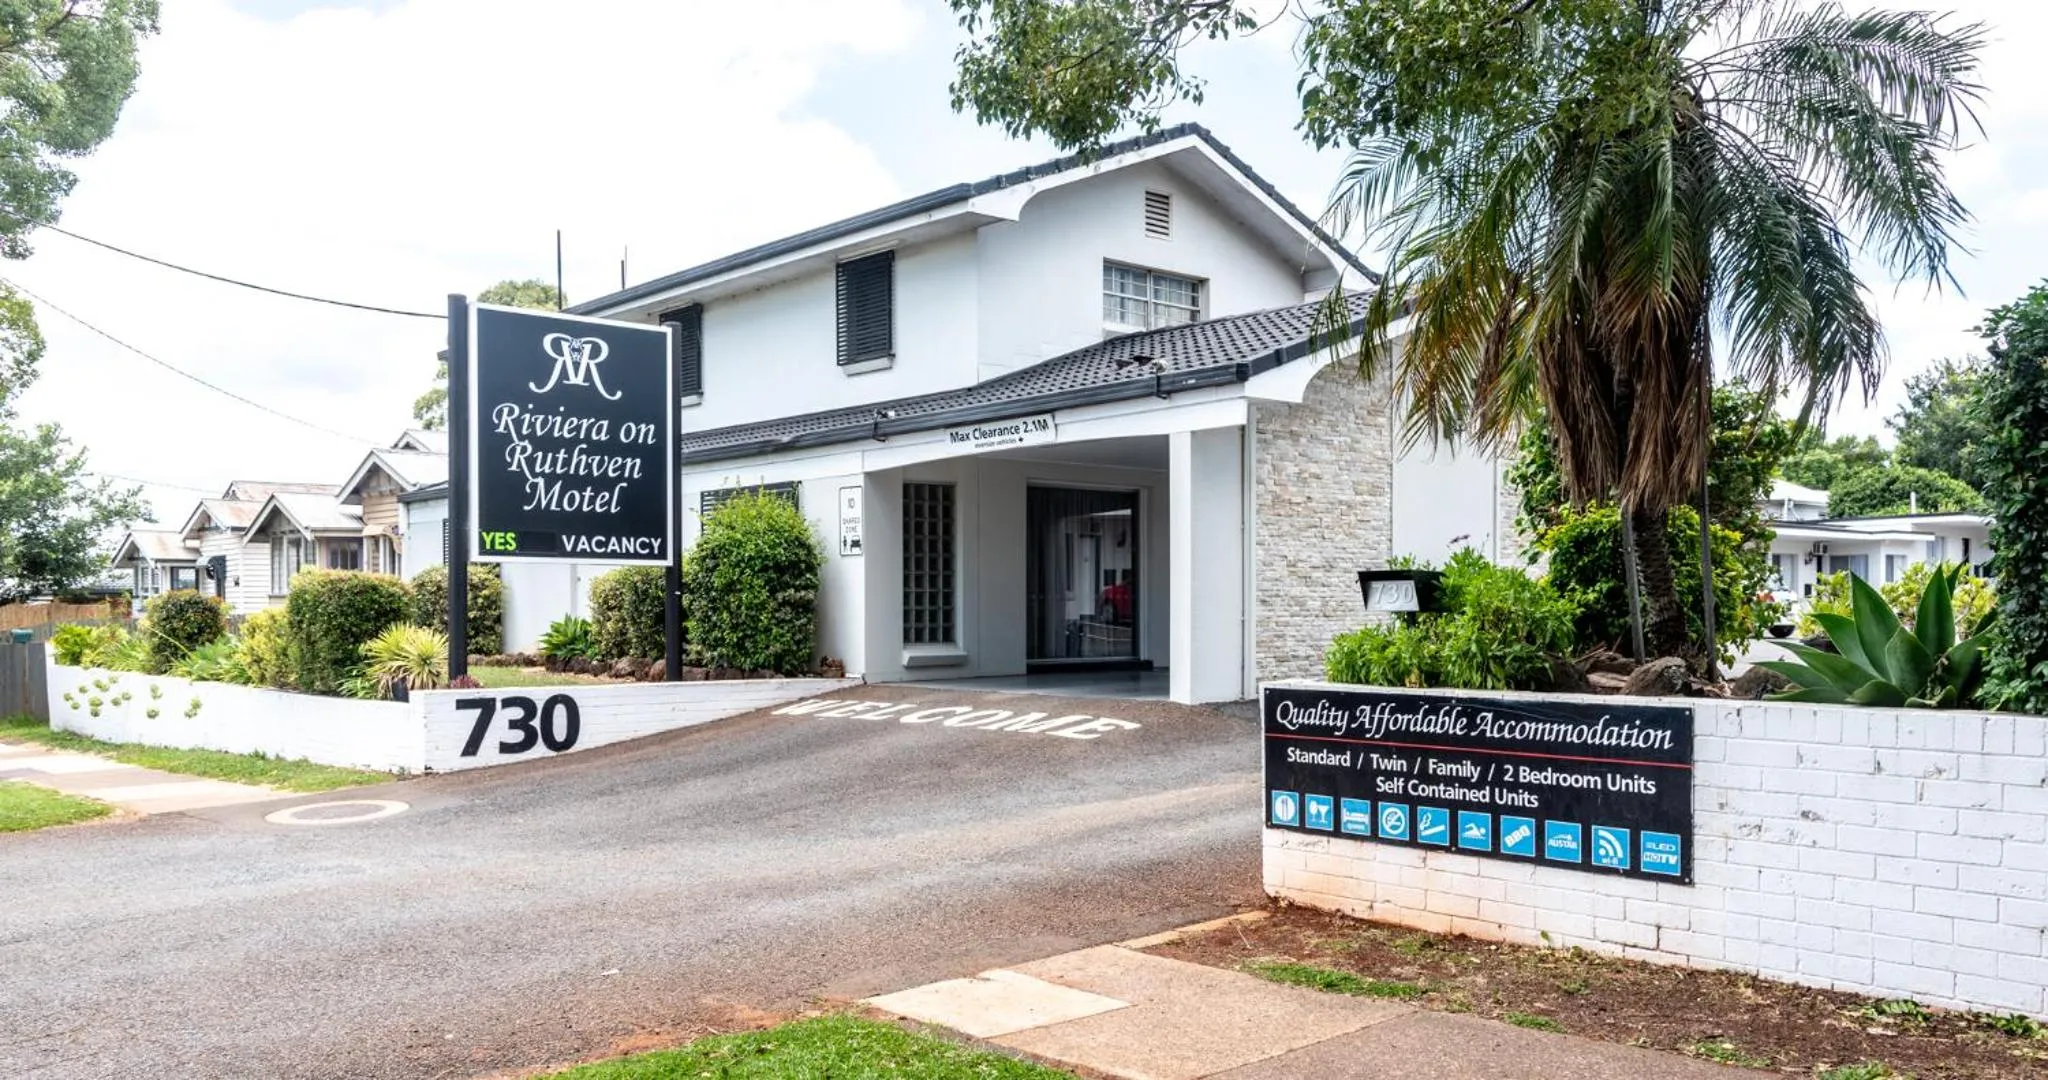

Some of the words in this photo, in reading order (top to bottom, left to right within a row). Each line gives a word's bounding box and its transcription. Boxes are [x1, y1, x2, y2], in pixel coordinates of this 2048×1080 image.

[492, 402, 610, 445] Riviera
[620, 421, 657, 445] on
[949, 431, 970, 443] Max
[973, 425, 1020, 440] Clearance
[1022, 418, 1049, 433] 2.1M
[504, 441, 642, 480] Ruthven
[523, 476, 628, 514] Motel
[481, 531, 517, 551] YES
[561, 534, 662, 554] VACANCY
[1371, 583, 1414, 605] 730
[455, 693, 580, 757] 730
[772, 698, 1141, 740] WELCOME
[1275, 699, 1349, 736] Quality
[1350, 703, 1467, 739] Affordable
[1470, 711, 1674, 751] Accommodation
[1287, 746, 1351, 768] Standard
[1357, 752, 1364, 769] /
[1370, 753, 1408, 773] Twin
[1413, 757, 1421, 774] /
[1428, 758, 1482, 781] Family
[1487, 763, 1496, 780] /
[1503, 765, 1515, 782] 2
[1519, 766, 1602, 790] Bedroom
[1607, 774, 1656, 795] Units
[1376, 776, 1405, 795] Self
[1408, 780, 1491, 803] Contained
[1494, 789, 1539, 808] Units
[1504, 824, 1531, 848] BBQ
[1547, 838, 1578, 850] AUSTAR
